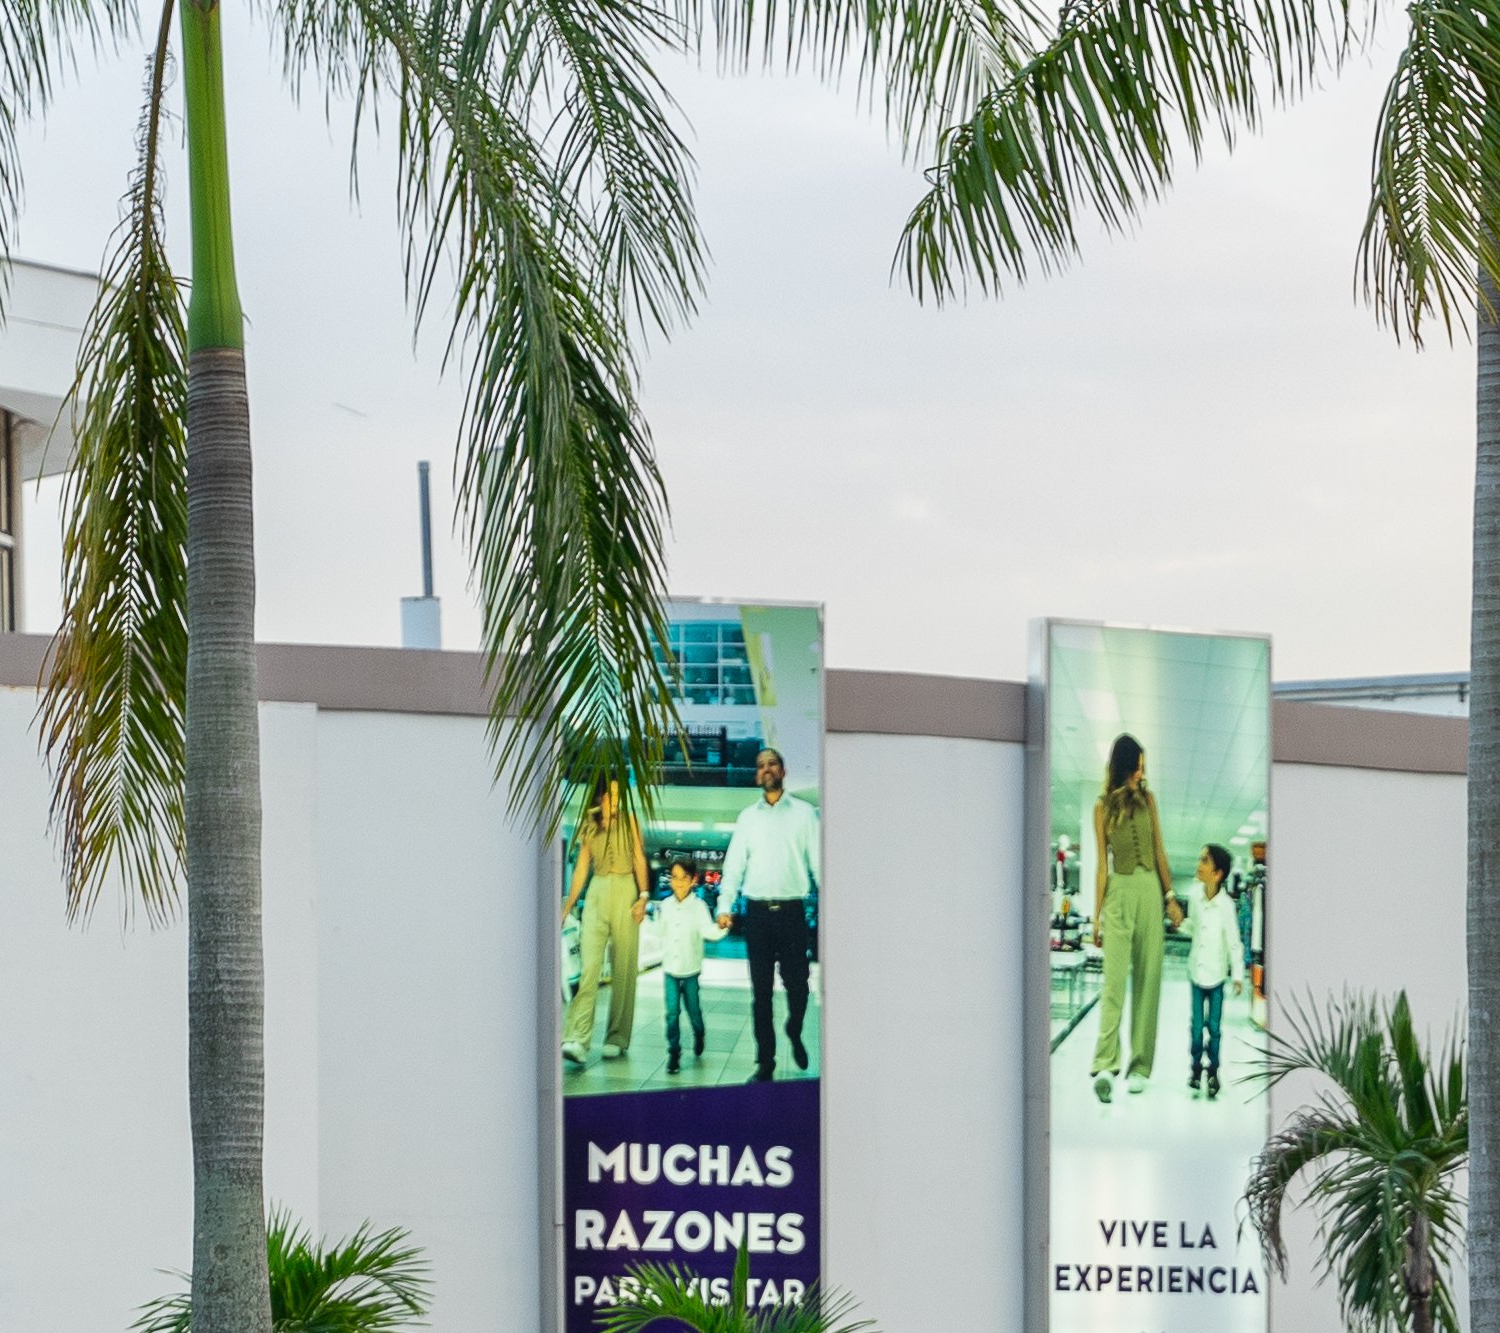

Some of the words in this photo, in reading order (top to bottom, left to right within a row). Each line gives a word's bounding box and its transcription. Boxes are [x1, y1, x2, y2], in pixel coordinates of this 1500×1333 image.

[588, 1141, 794, 1187] MUCHAS
[575, 1209, 806, 1254] RAZONES
[1099, 1219, 1168, 1248] VIVE
[1180, 1221, 1217, 1249] LA
[675, 1277, 806, 1308] VISTAR
[1055, 1264, 1260, 1294] EXPERIENCIA
